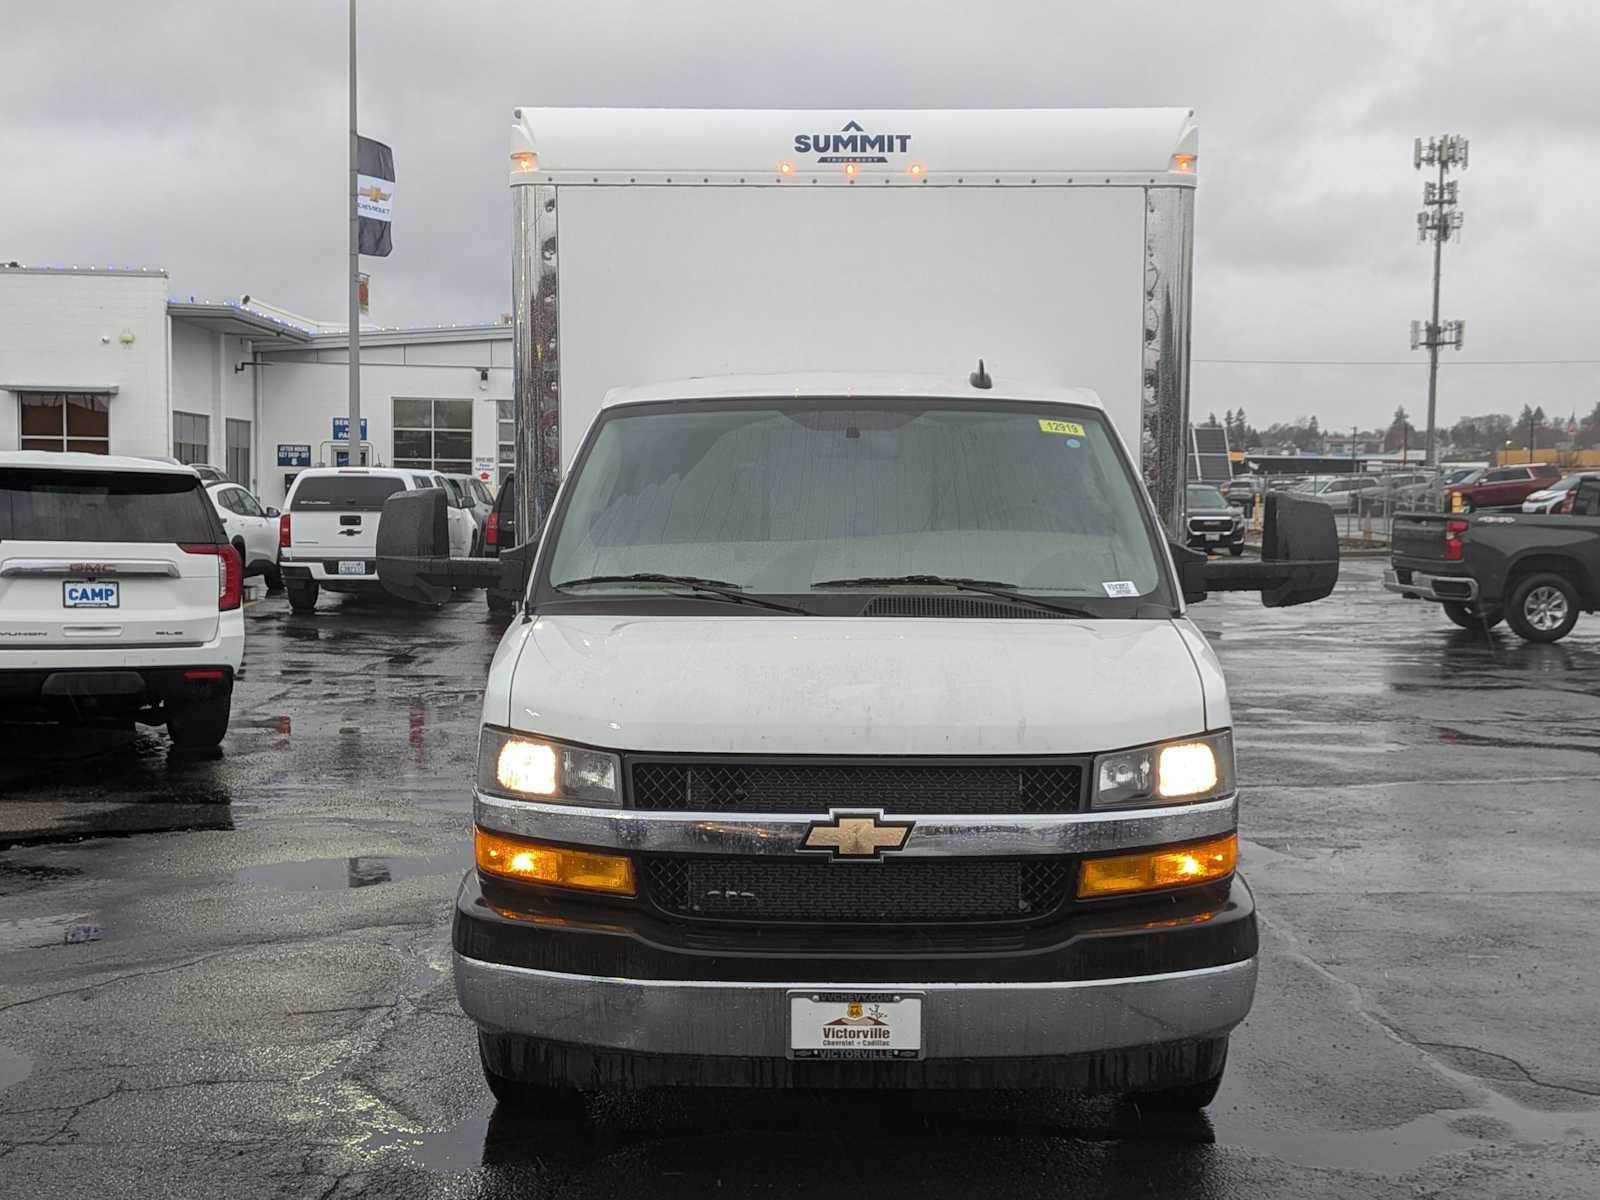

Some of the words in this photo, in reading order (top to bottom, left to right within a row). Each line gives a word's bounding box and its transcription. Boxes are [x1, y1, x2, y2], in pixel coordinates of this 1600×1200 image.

[794, 134, 912, 153] SUMMIT
[68, 588, 115, 601] CAMP
[822, 1027, 891, 1040] Victorville
[820, 1048, 894, 1059] VICTORVILLE
